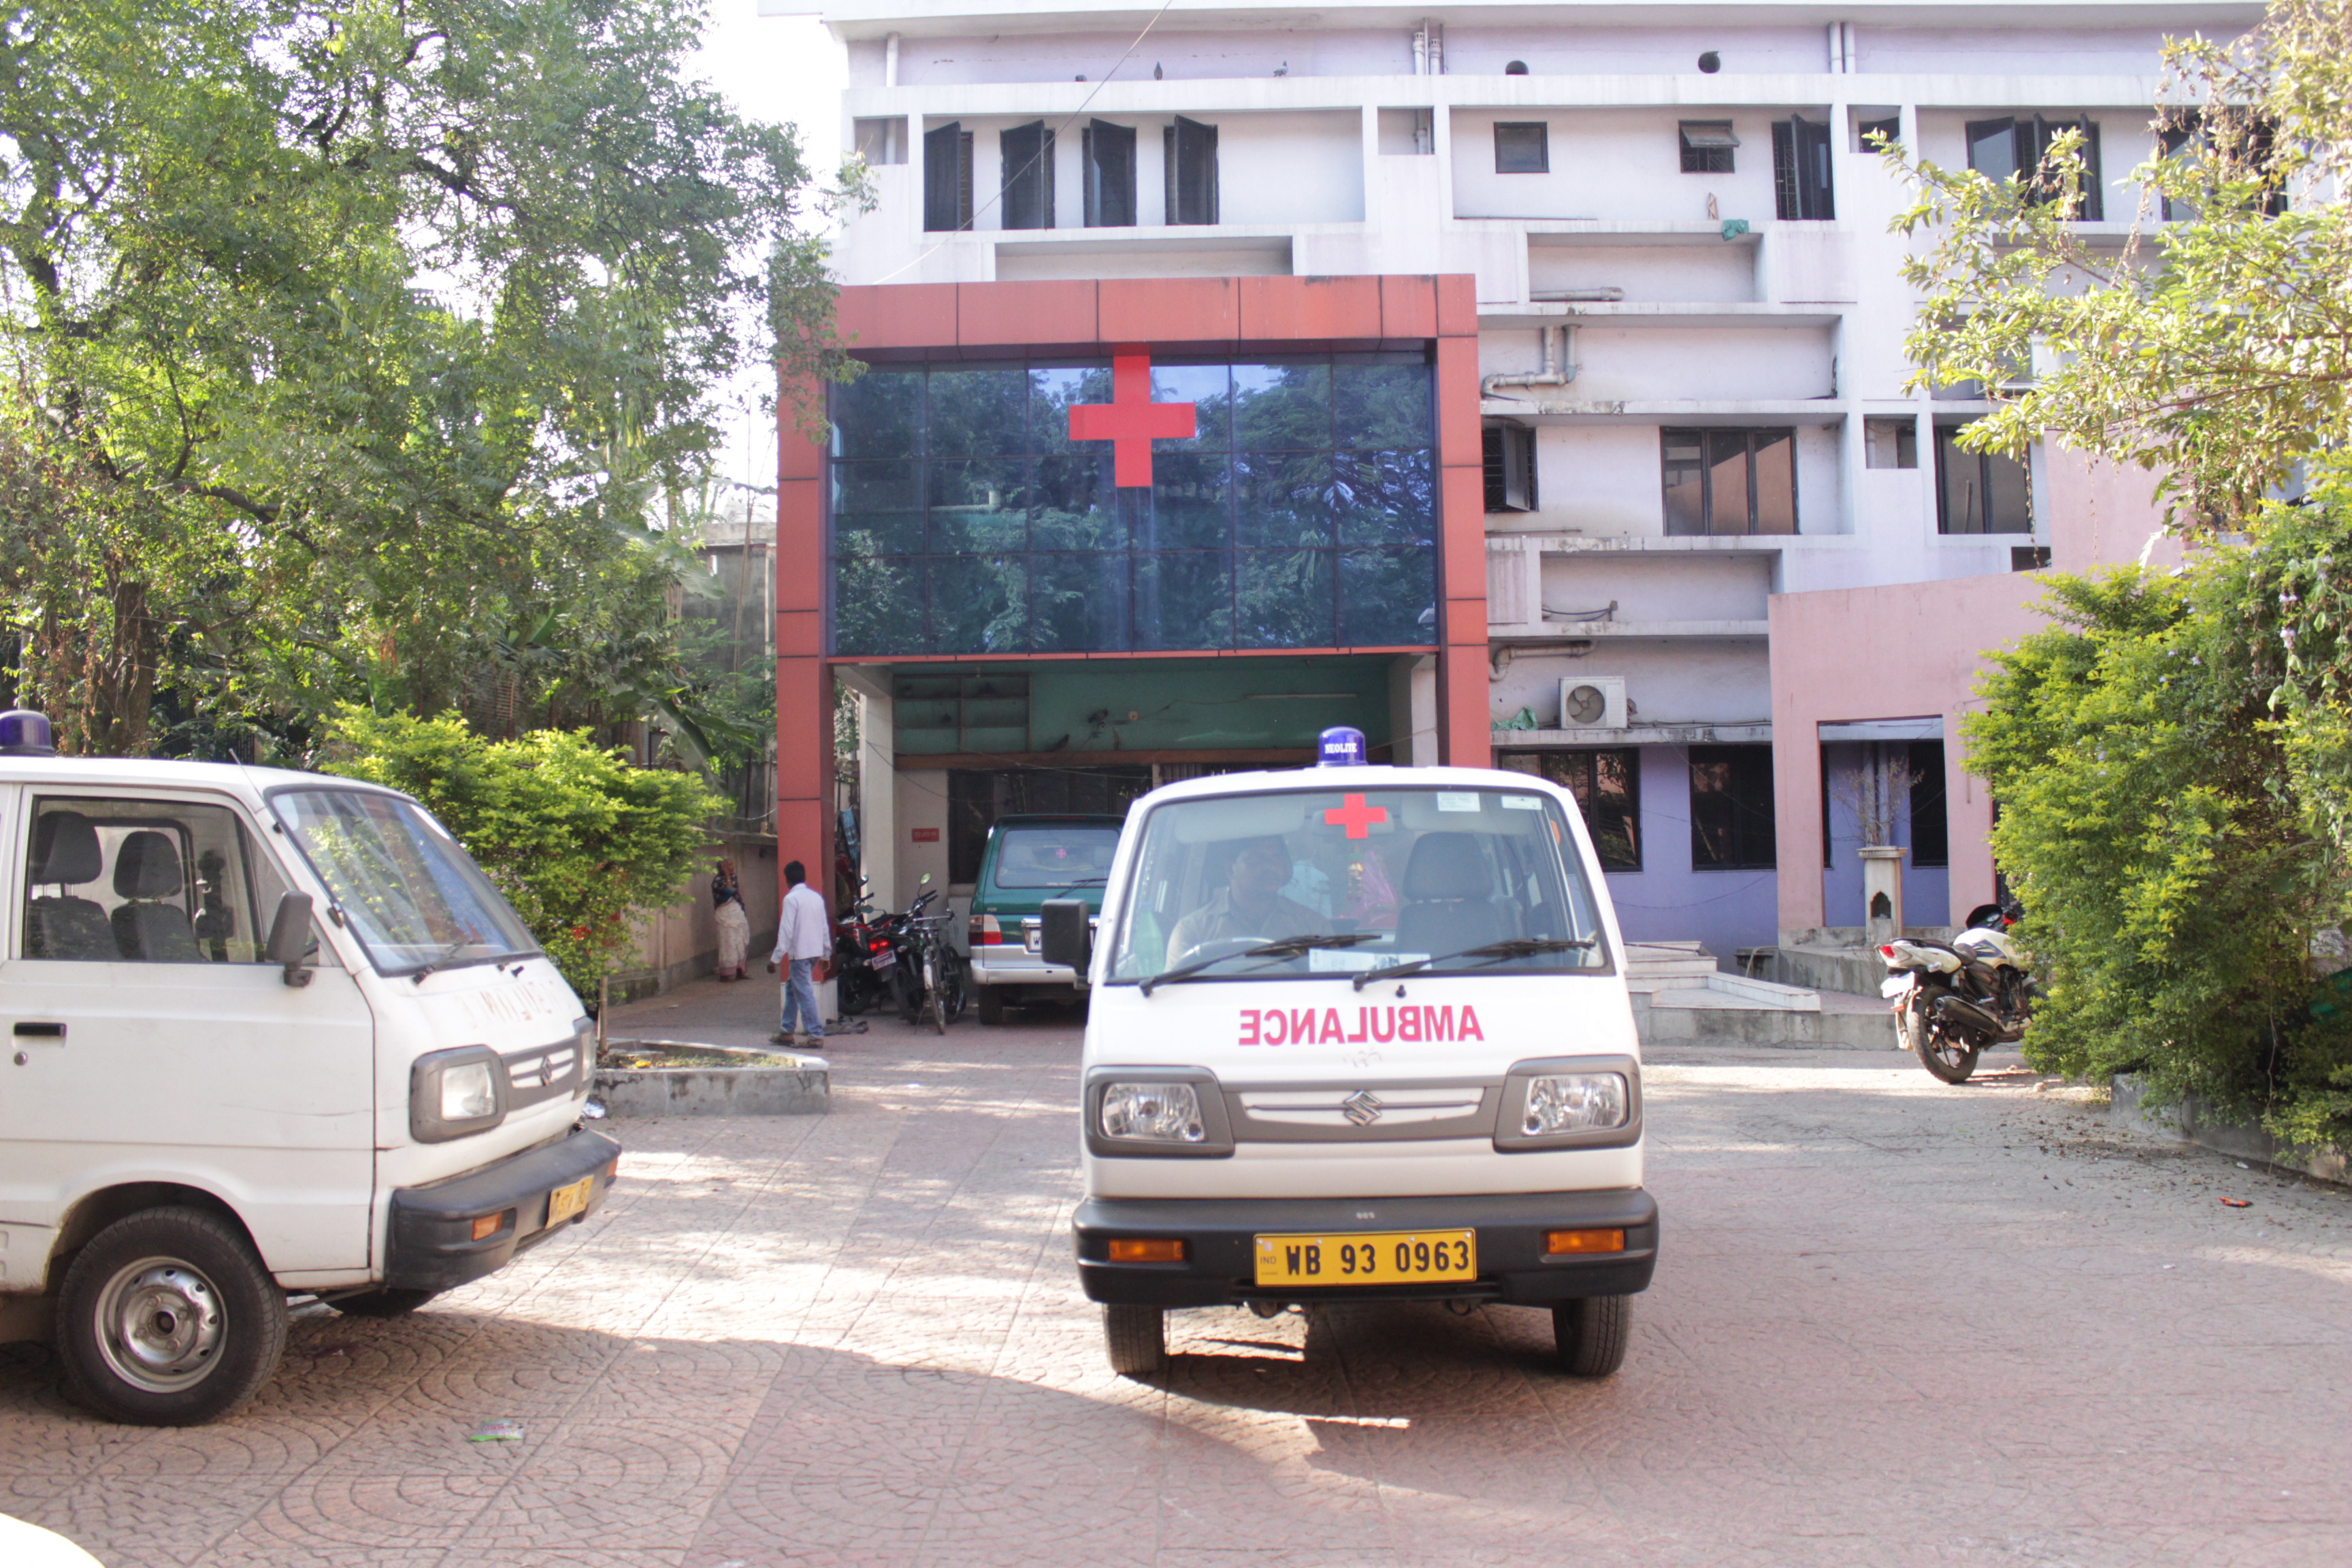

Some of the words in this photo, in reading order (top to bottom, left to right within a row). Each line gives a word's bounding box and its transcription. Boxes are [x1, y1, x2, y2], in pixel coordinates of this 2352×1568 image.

[1324, 742, 1357, 754] NEOLITE
[1286, 1245, 1321, 1275] WB
[1341, 1243, 1375, 1274] 93
[1395, 1240, 1469, 1272] 0963
